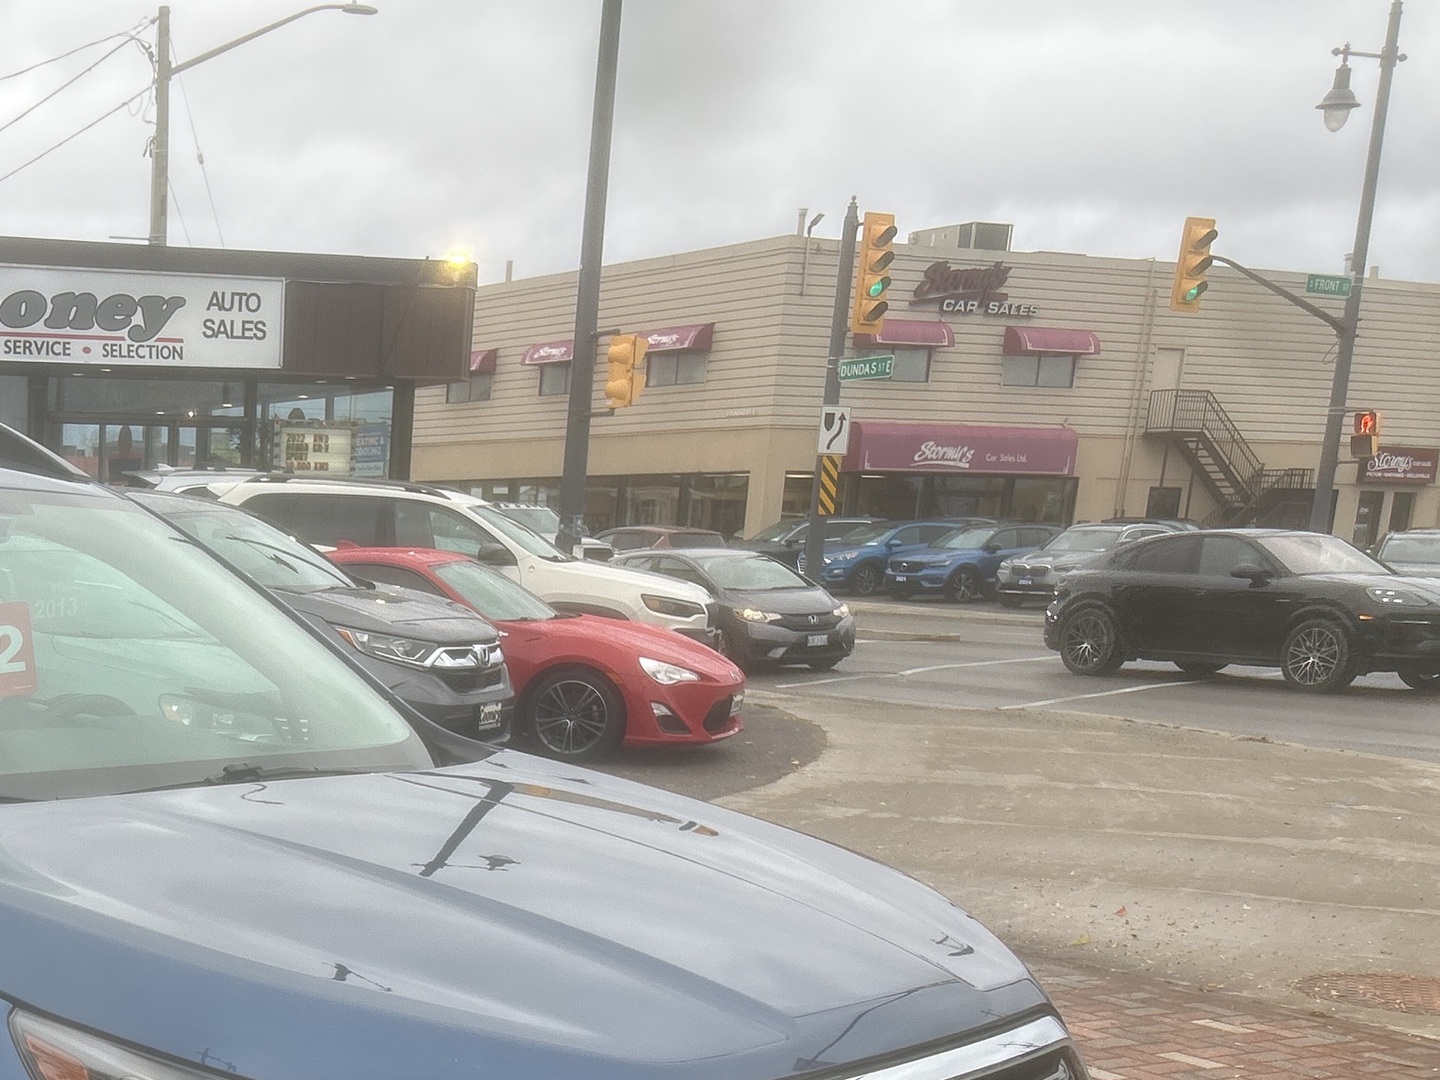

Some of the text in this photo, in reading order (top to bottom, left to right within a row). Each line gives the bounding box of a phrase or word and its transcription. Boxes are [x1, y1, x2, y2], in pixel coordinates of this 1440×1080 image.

[1315, 279, 1340, 291] FRONT
[206, 290, 261, 313] AUTO
[942, 299, 1040, 316] CAR SALES
[201, 318, 267, 341] SALES
[3, 339, 72, 357] SERVICE
[101, 342, 184, 361] SELECTION
[840, 360, 892, 377] DUNDAS ST E
[286, 433, 306, 442] 2022
[356, 436, 379, 447] EATING
[913, 441, 975, 463] Stormy's
[985, 453, 998, 462] Car
